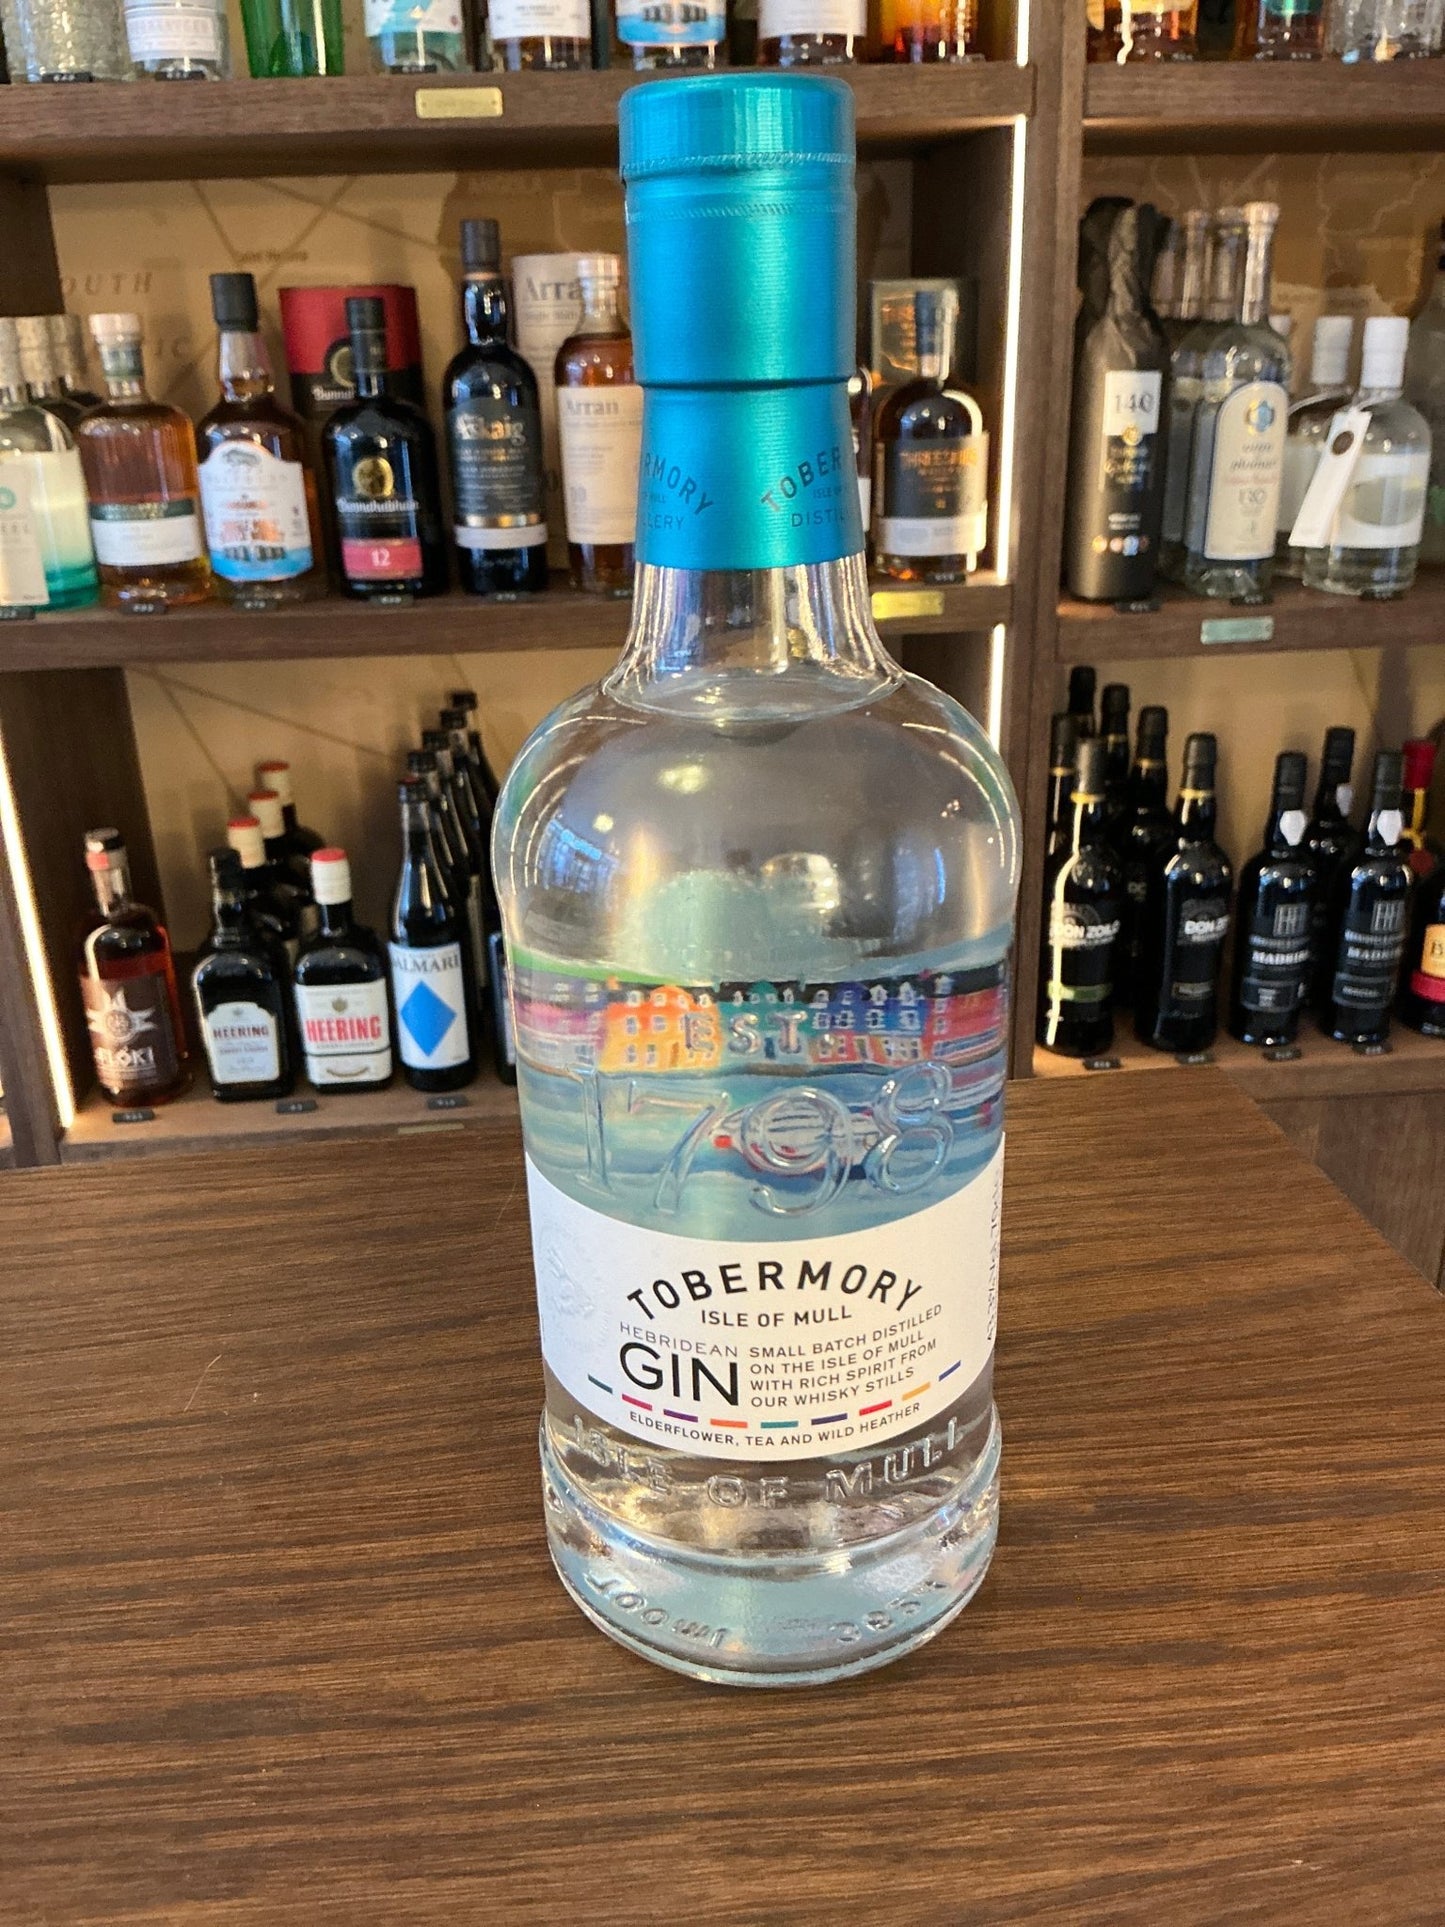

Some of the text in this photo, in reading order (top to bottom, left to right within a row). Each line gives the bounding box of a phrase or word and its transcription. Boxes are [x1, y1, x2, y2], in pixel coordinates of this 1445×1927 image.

[370, 548, 392, 567] 12
[212, 1024, 269, 1040] HEERING
[305, 1014, 382, 1043] HEERING
[566, 1060, 955, 1219] 1798
[626, 1259, 923, 1321] TOBERMORY
[701, 1304, 853, 1328] ISLE OF MULL
[749, 1303, 943, 1358] SMALL BATCH DISTILLED
[619, 1320, 738, 1358] HEBRIDEAN
[749, 1330, 925, 1376] ON THE ISLE OF MULL
[619, 1341, 740, 1407] GIN
[750, 1337, 938, 1392] WITH RICH SPIRIT FROM
[751, 1366, 915, 1408] OUR WHISKY STILLS
[629, 1402, 922, 1447] ELDERFLOWER, TEA AND WILD HEATHER
[706, 1474, 790, 1510] OF
